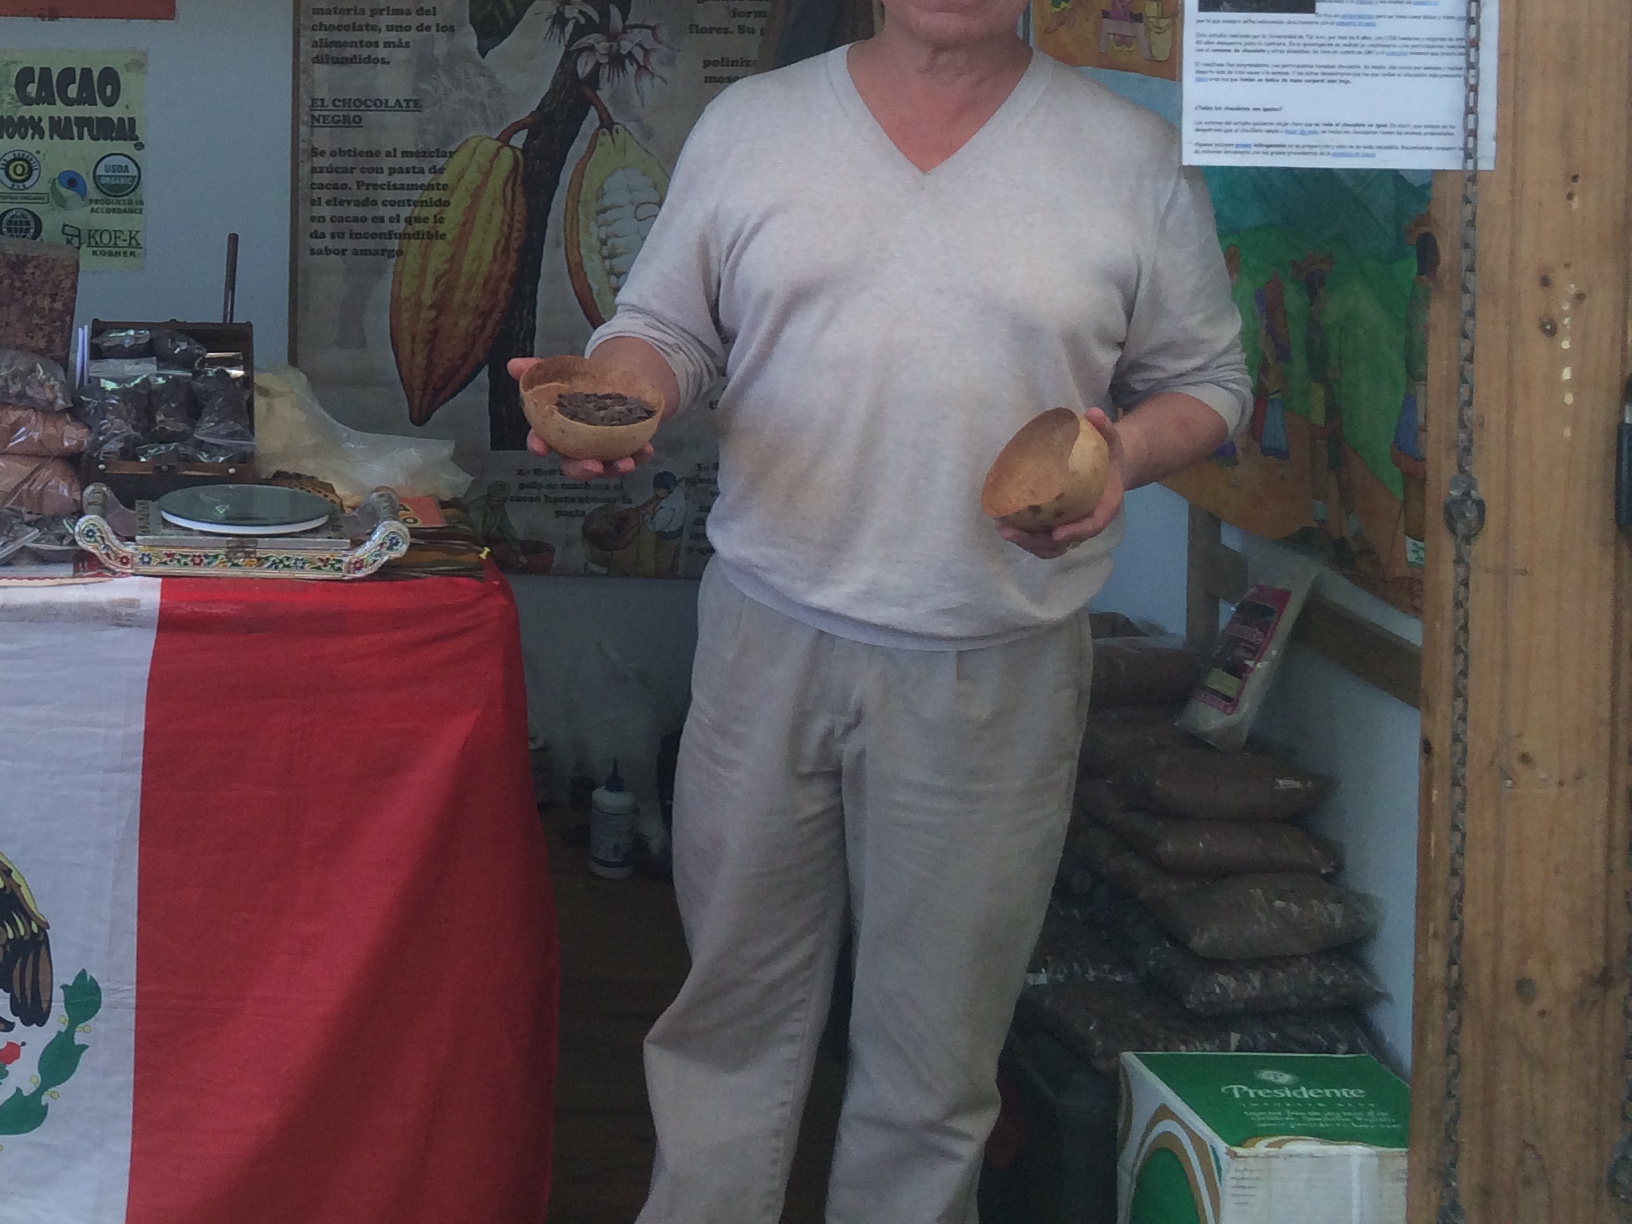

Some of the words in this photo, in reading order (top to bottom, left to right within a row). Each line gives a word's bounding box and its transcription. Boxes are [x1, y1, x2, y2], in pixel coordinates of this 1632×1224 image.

[312, 6, 366, 15] materia
[370, 6, 411, 17] prima
[416, 6, 437, 16] del
[311, 22, 382, 33] chocolate,
[386, 24, 411, 32] uno
[415, 23, 431, 32] de
[435, 23, 455, 32] los
[311, 38, 379, 48] alimentos
[15, 66, 121, 107] CACAO
[310, 98, 328, 108] EL
[332, 98, 422, 108] CHOCOLATE
[310, 114, 362, 124] NEGRO
[48, 116, 139, 141] NATURAL
[310, 147, 326, 157] Se
[330, 148, 381, 158] obtiene
[385, 148, 397, 158] al
[401, 148, 455, 158] mezclar
[104, 164, 129, 173] USDA
[310, 164, 356, 174] azúcar
[388, 165, 425, 176] pasta
[429, 164, 445, 174] de
[310, 182, 352, 190] cacao.
[356, 180, 448, 191] Precisamente
[310, 197, 322, 206] el
[326, 197, 378, 207] elevado
[381, 198, 450, 207] contenido
[310, 215, 326, 223] en
[330, 215, 367, 223] cacao
[371, 215, 385, 223] es
[389, 214, 400, 223] el
[404, 216, 429, 226] que
[433, 214, 445, 224] le
[87, 230, 141, 246] KOF-K
[310, 230, 326, 239] da
[349, 230, 446, 240] inconfundible
[310, 246, 348, 255] sabor
[351, 248, 403, 258] amargo
[1221, 1084, 1365, 1099] Presidente
